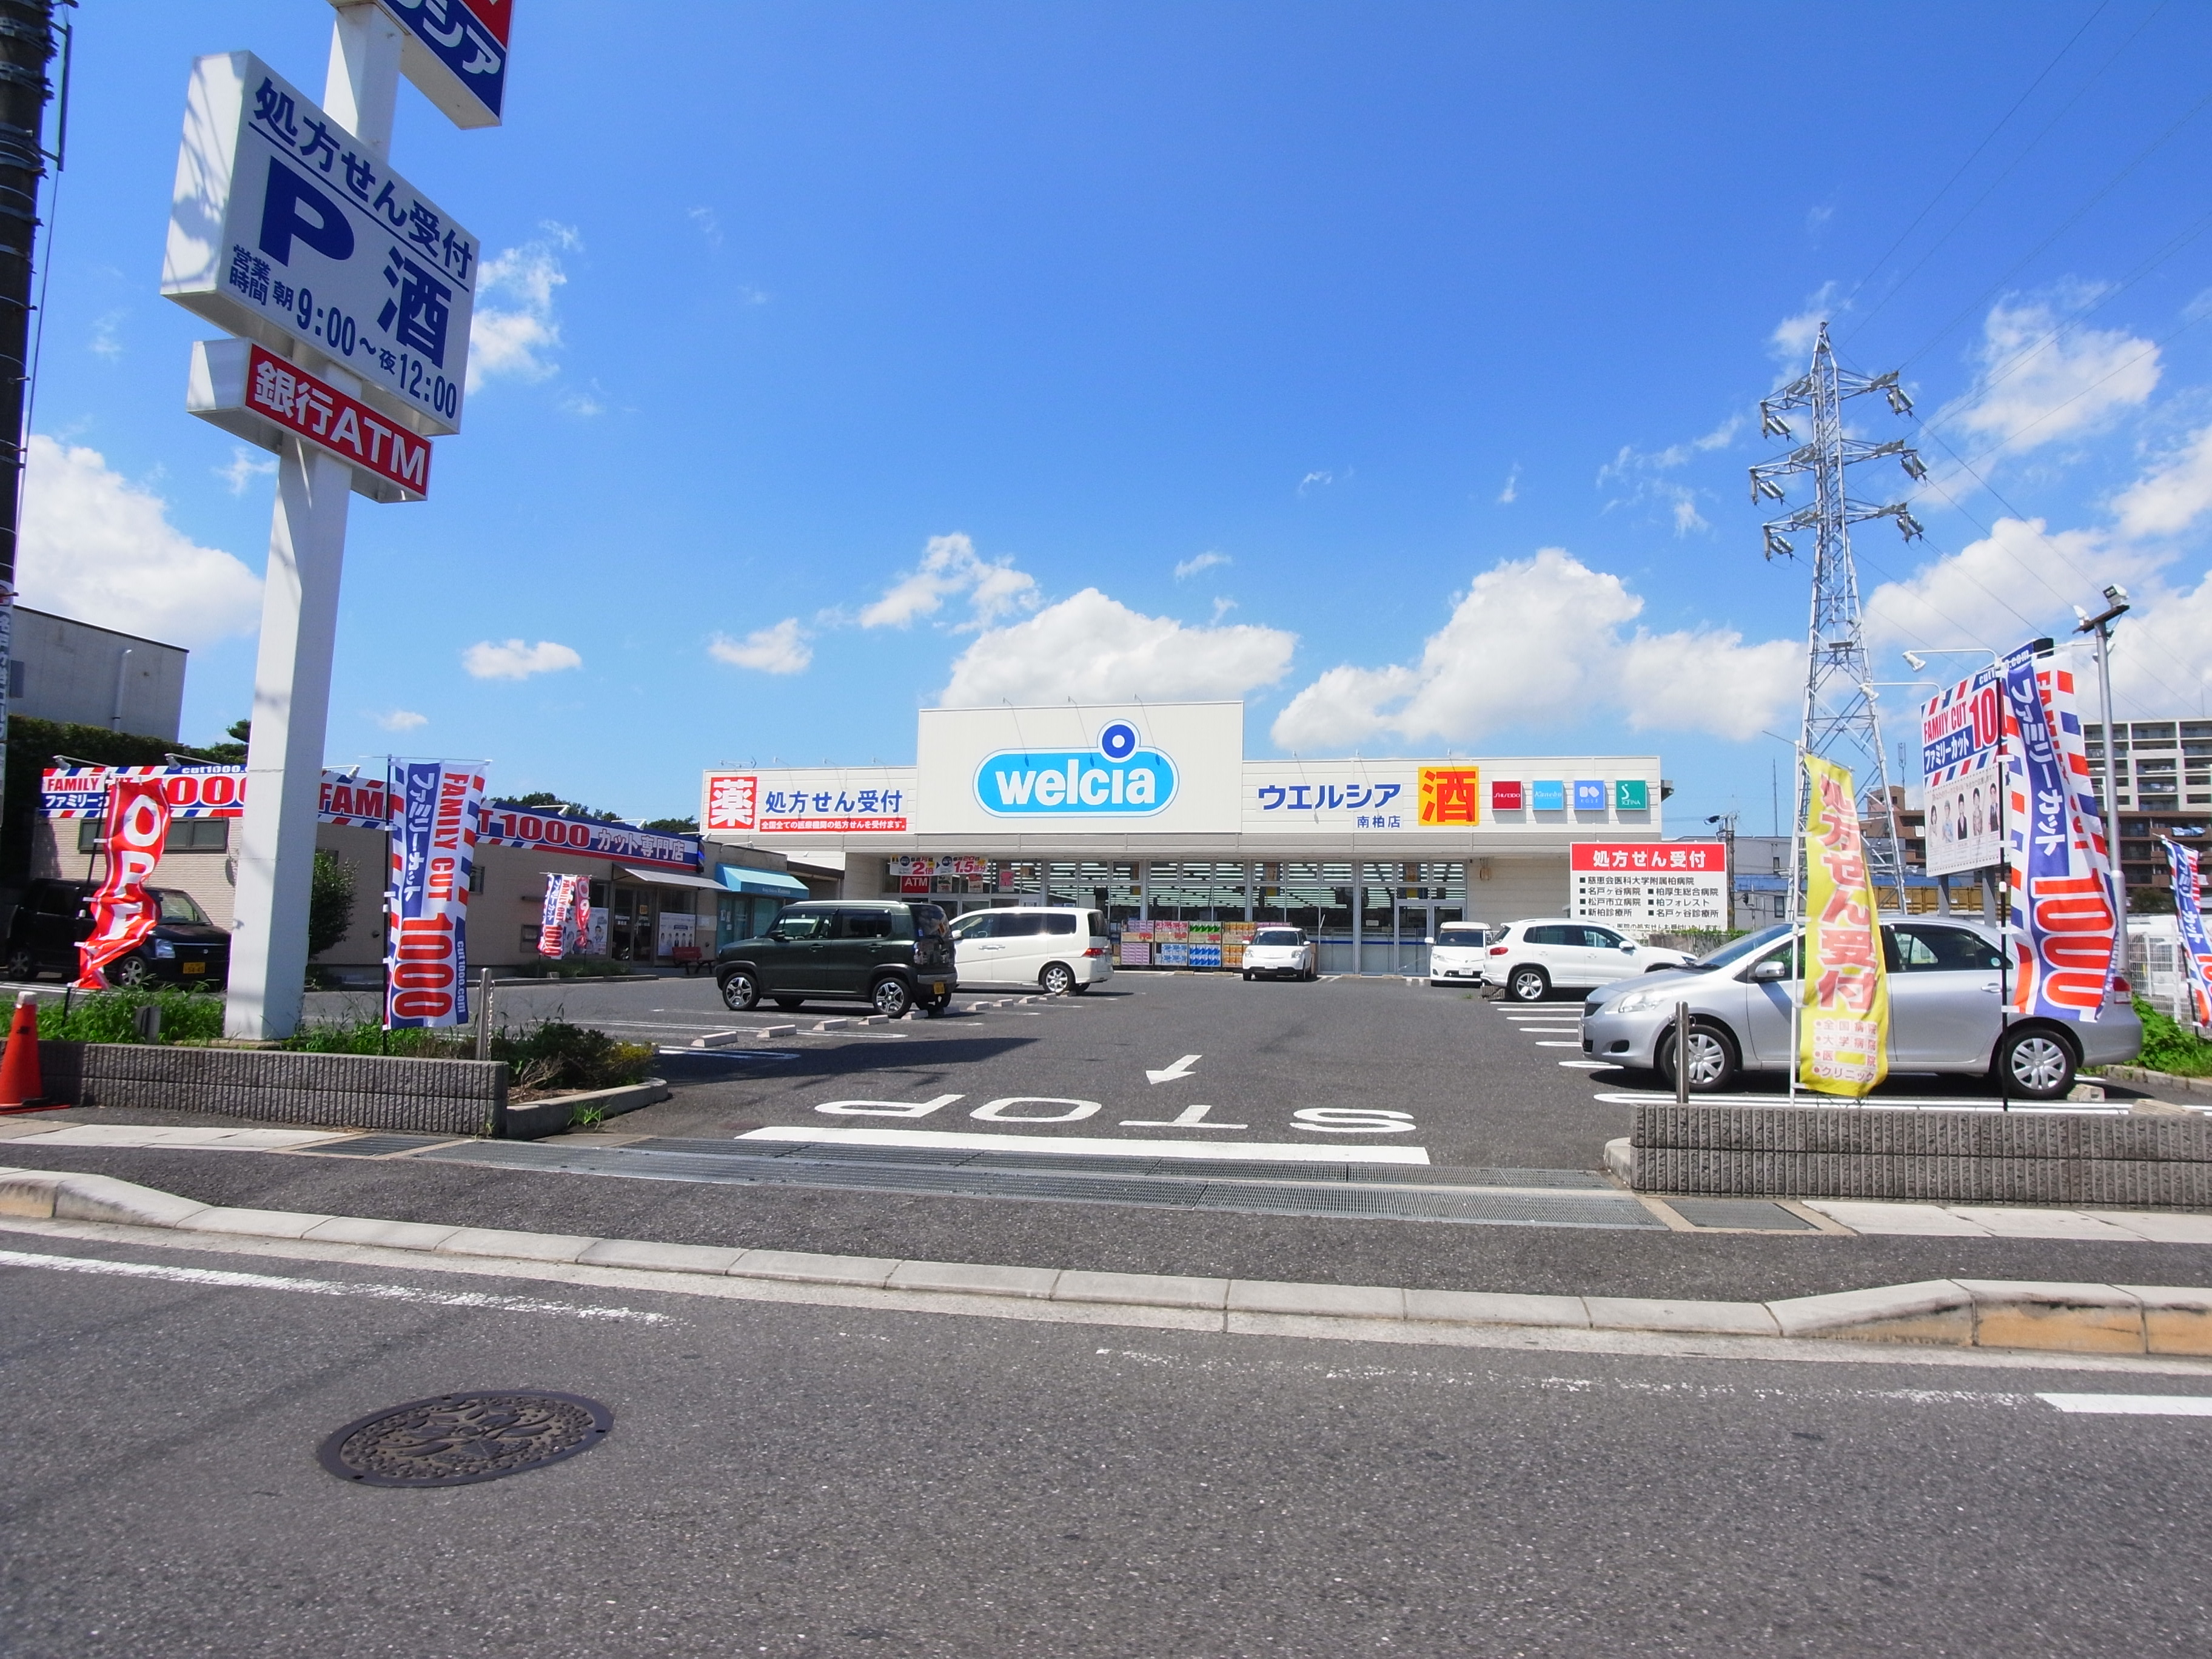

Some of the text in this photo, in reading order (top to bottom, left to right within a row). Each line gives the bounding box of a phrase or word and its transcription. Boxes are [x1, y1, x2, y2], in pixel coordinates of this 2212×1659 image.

[253, 76, 473, 280] 処方せん受付
[258, 155, 355, 267] P
[233, 244, 271, 285] 営業
[229, 266, 268, 306] 時間
[377, 246, 452, 369] 酒
[254, 360, 426, 486] 銀行ATM
[1951, 701, 1966, 730] CUT
[1925, 731, 1969, 771] ファミリーカット
[2011, 678, 2063, 856] ファミリーカット
[47, 777, 99, 791] FAMILY
[765, 789, 903, 814] 処方せん受付
[995, 759, 1156, 806] welcia
[1258, 783, 1401, 811] ウエルシア
[1422, 770, 1476, 822] 酒
[711, 780, 753, 826] 薬
[1356, 815, 1401, 828] 南柏店
[403, 773, 435, 902] ファミリーカット
[427, 773, 470, 902] FAMILY CUT
[499, 813, 590, 847] 1000
[598, 829, 685, 861] カット専門店
[1593, 850, 1707, 868] 処方せん受付
[558, 879, 570, 906] FAMILY
[905, 878, 928, 887] ATM
[1587, 876, 1695, 885] 慈恵会医科大学附属柏病院
[1656, 888, 1719, 896] 柏厚生総合病院
[1818, 774, 1879, 1012] 処方せん受付
[2177, 853, 2204, 944] ファミリーカット
[1587, 898, 1710, 907] 松戸市立病院 柏フォレスト
[1587, 908, 1632, 917] 新柏診療所
[394, 912, 455, 1017] 1000
[457, 940, 466, 1013] cut1000.com
[1822, 1067, 1874, 1082] クリニック
[813, 1093, 1418, 1134] STOP
